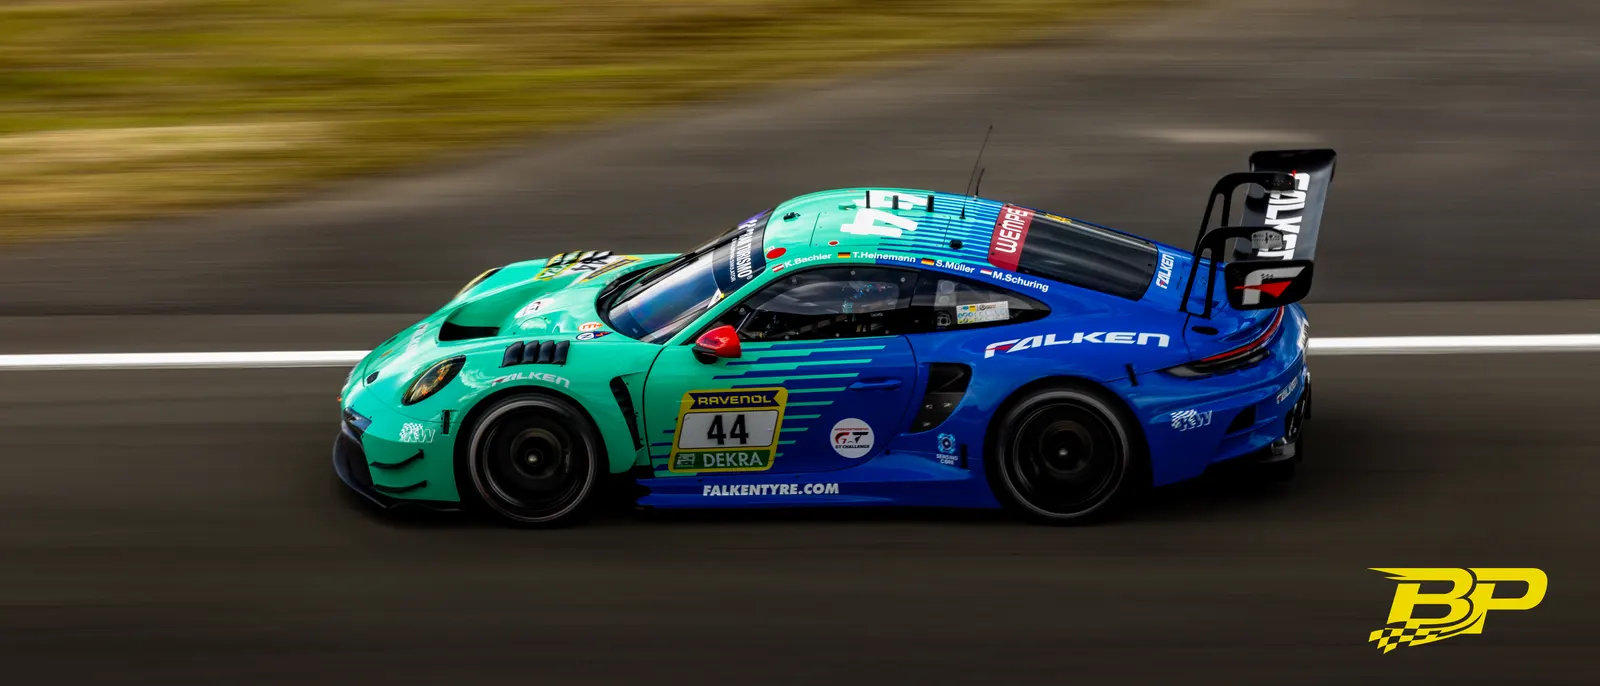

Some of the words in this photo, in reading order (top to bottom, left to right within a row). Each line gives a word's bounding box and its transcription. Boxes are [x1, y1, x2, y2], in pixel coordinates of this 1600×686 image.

[995, 207, 1029, 253] WEMPE
[785, 253, 832, 268] K.Bachler
[853, 251, 916, 263] T.Heinemann
[936, 260, 975, 274] S.Müller
[1156, 253, 1175, 290] FALKEN
[992, 271, 1049, 292] M.Schuring
[984, 331, 1170, 359] FALKEN
[491, 372, 570, 388] FALKEN
[697, 395, 772, 406] RAVENOL
[707, 414, 749, 445] 44
[703, 451, 763, 467] DEKRA
[703, 483, 839, 496] FALKENTYRE.COM
